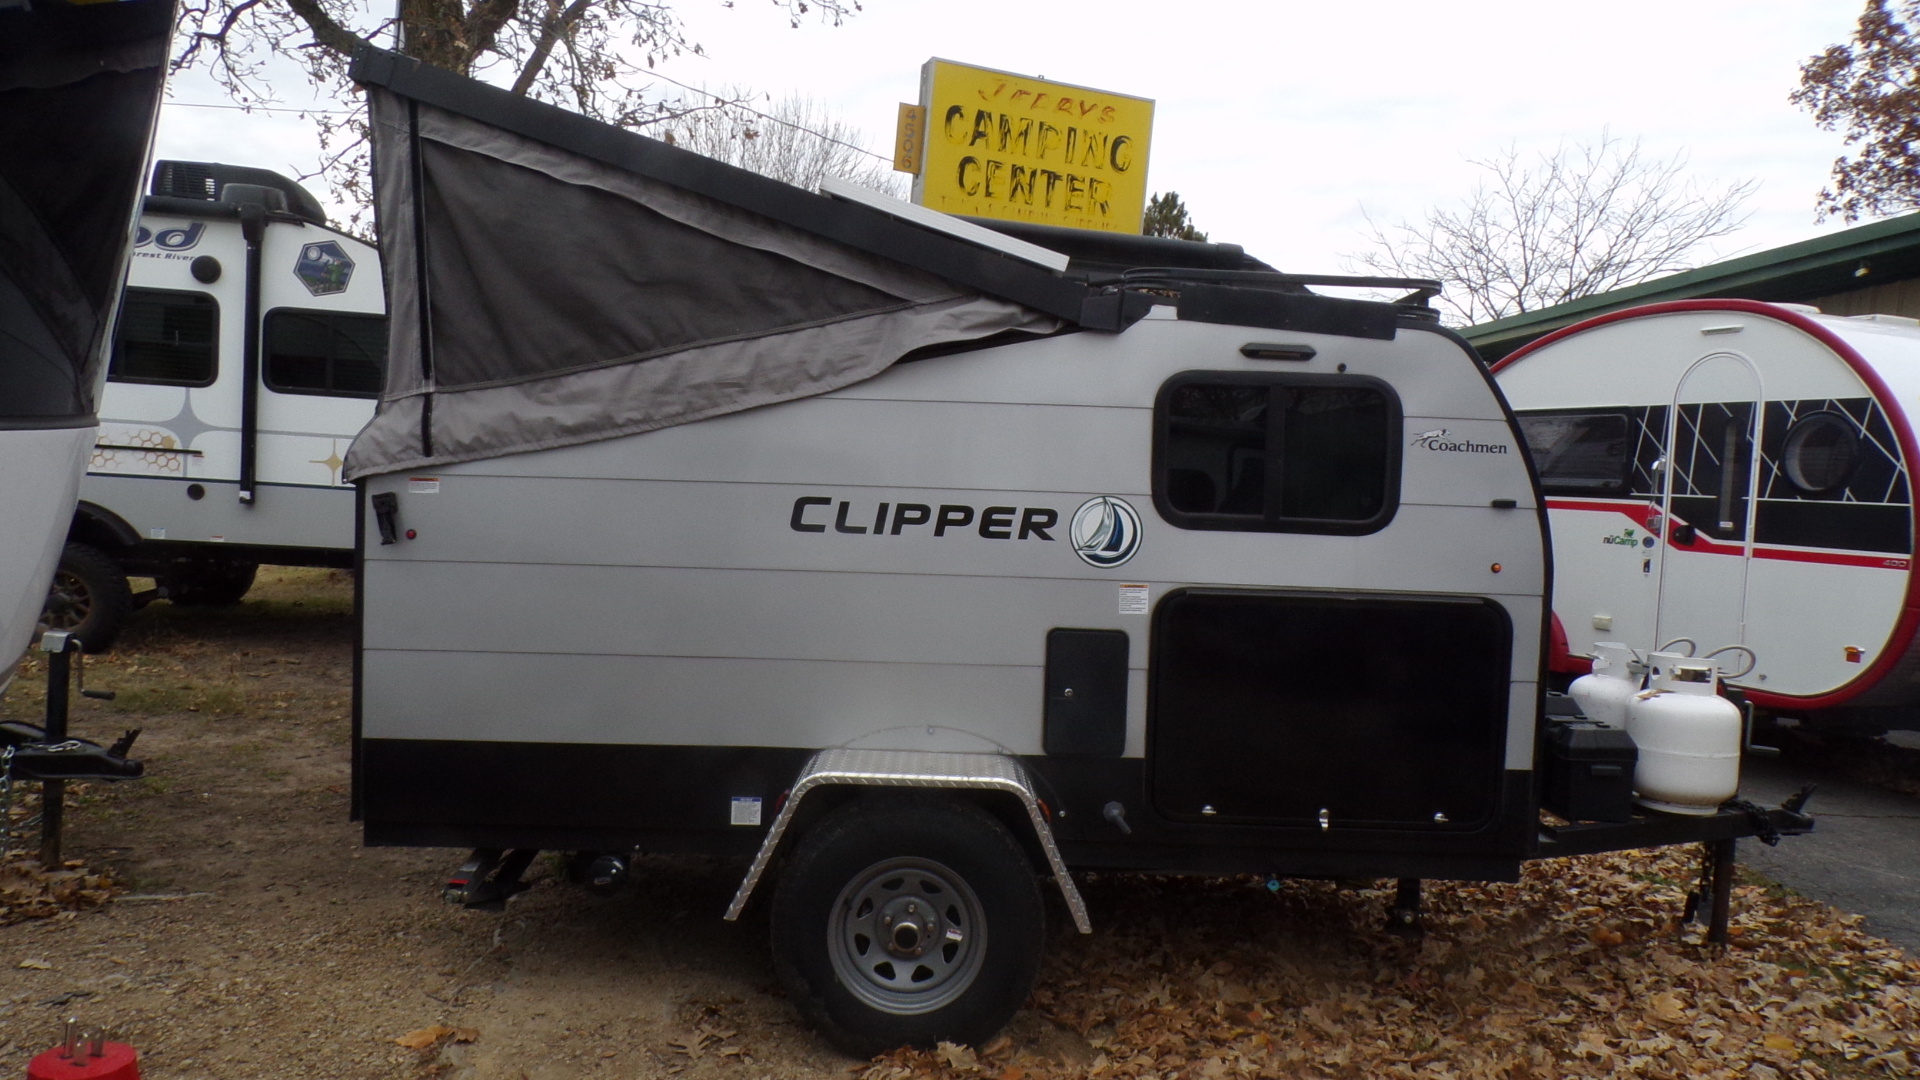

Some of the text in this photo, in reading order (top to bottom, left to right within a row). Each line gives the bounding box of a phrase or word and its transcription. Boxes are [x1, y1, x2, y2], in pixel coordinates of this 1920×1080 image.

[944, 104, 1133, 174] CAMPING
[956, 155, 1114, 217] CENTER
[164, 253, 195, 261] River
[1428, 439, 1507, 454] Coachmen
[790, 496, 1059, 542] CLIPPER
